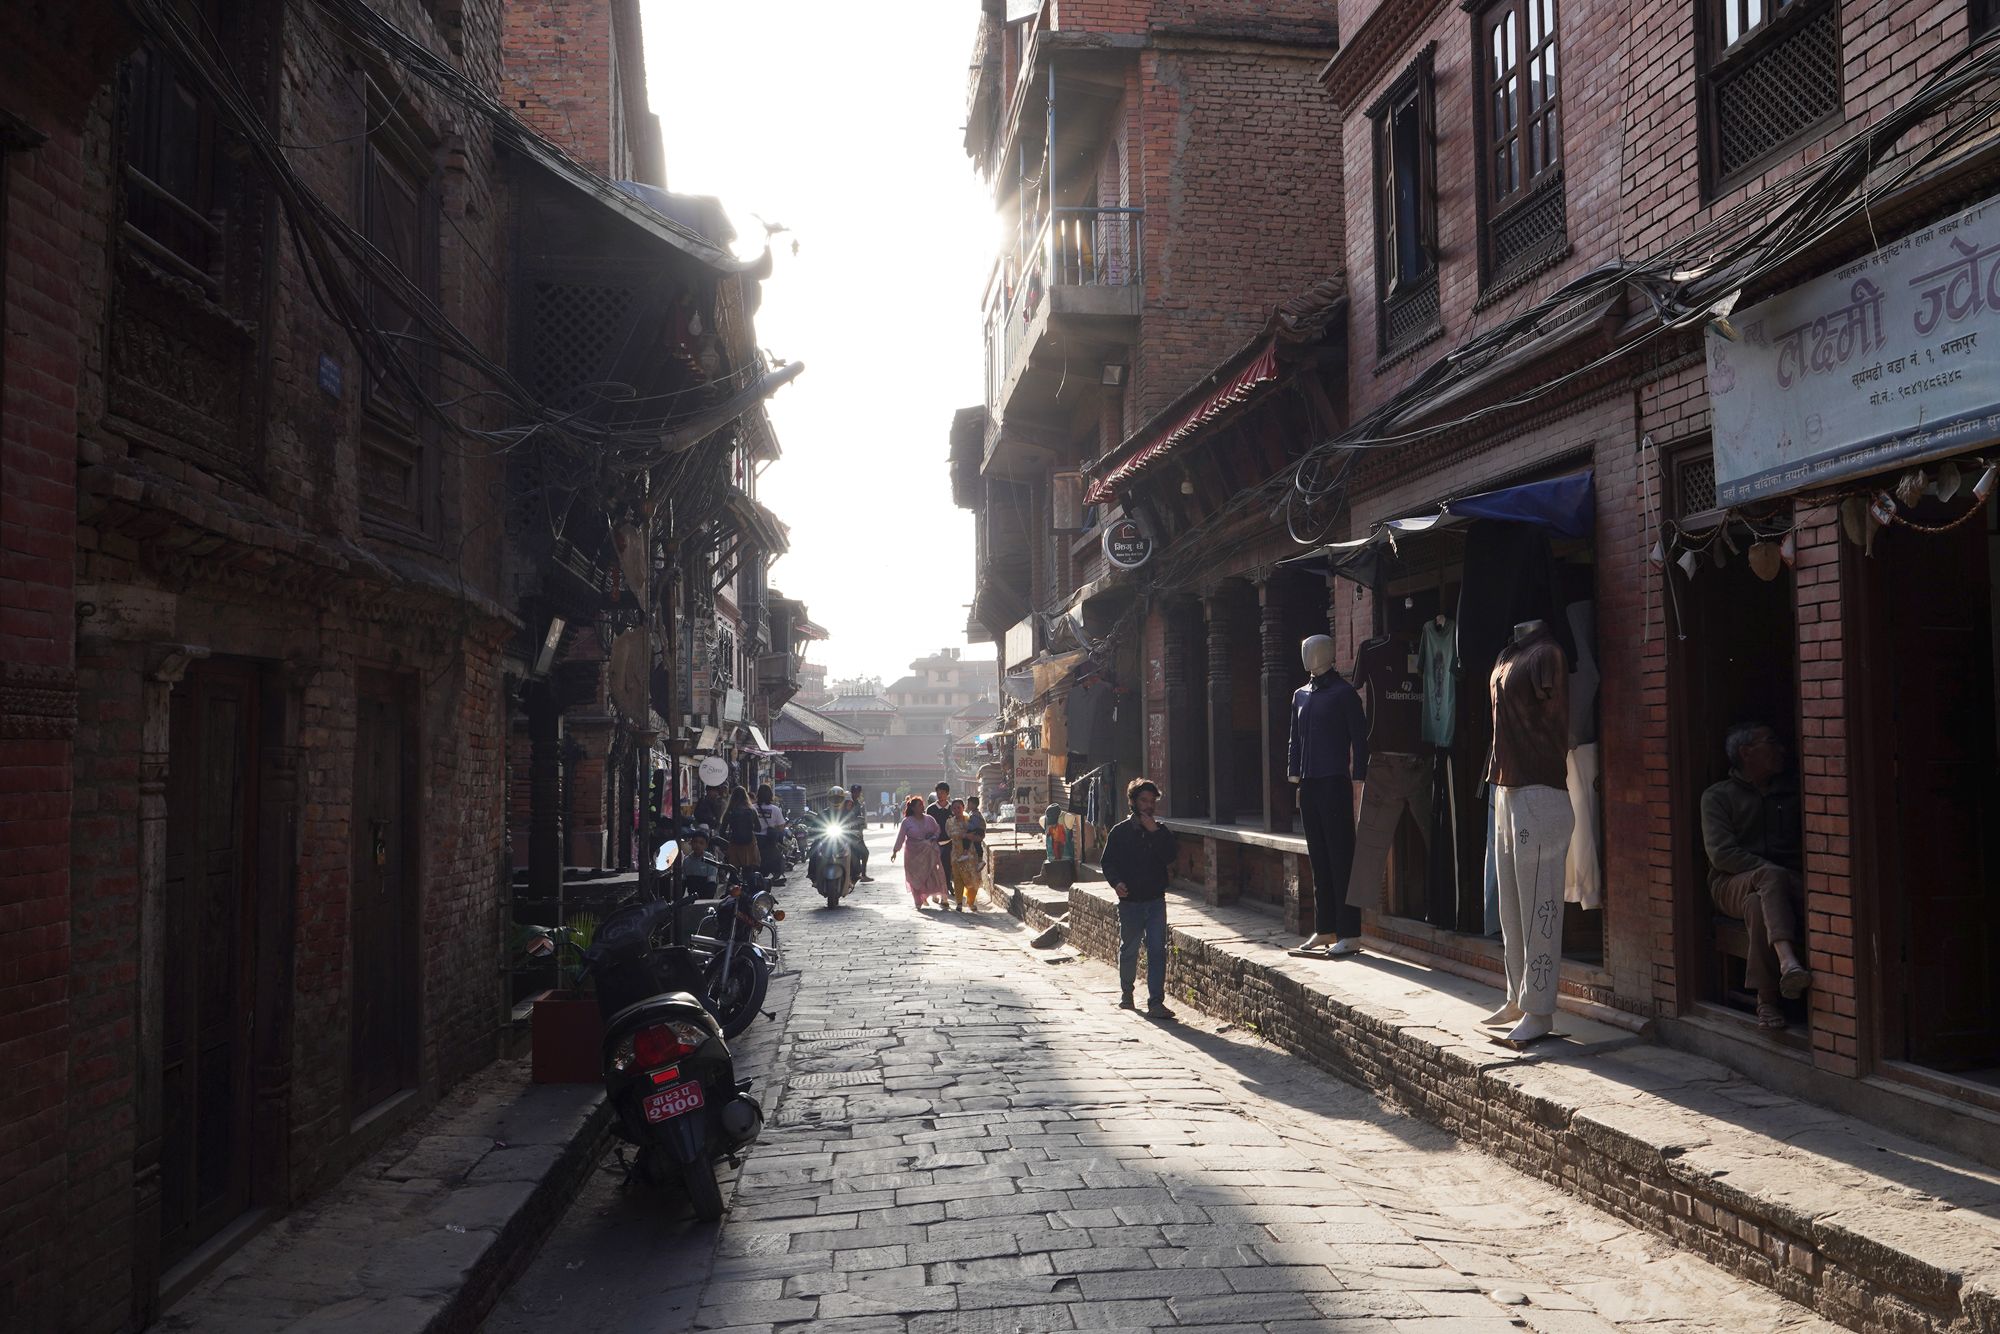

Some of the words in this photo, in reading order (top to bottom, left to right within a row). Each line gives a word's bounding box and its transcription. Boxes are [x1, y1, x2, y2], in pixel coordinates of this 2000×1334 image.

[1938, 220, 1959, 235] लक्ष्य
[1773, 277, 1886, 389] लक्ष्मी
[1887, 357, 1906, 374] वडा
[1910, 350, 1920, 366] नं.
[1940, 332, 1978, 354] भक्तपुर
[1785, 464, 1809, 481] तयारी
[1814, 458, 1835, 472] गहना
[649, 1094, 698, 1119] २१००
